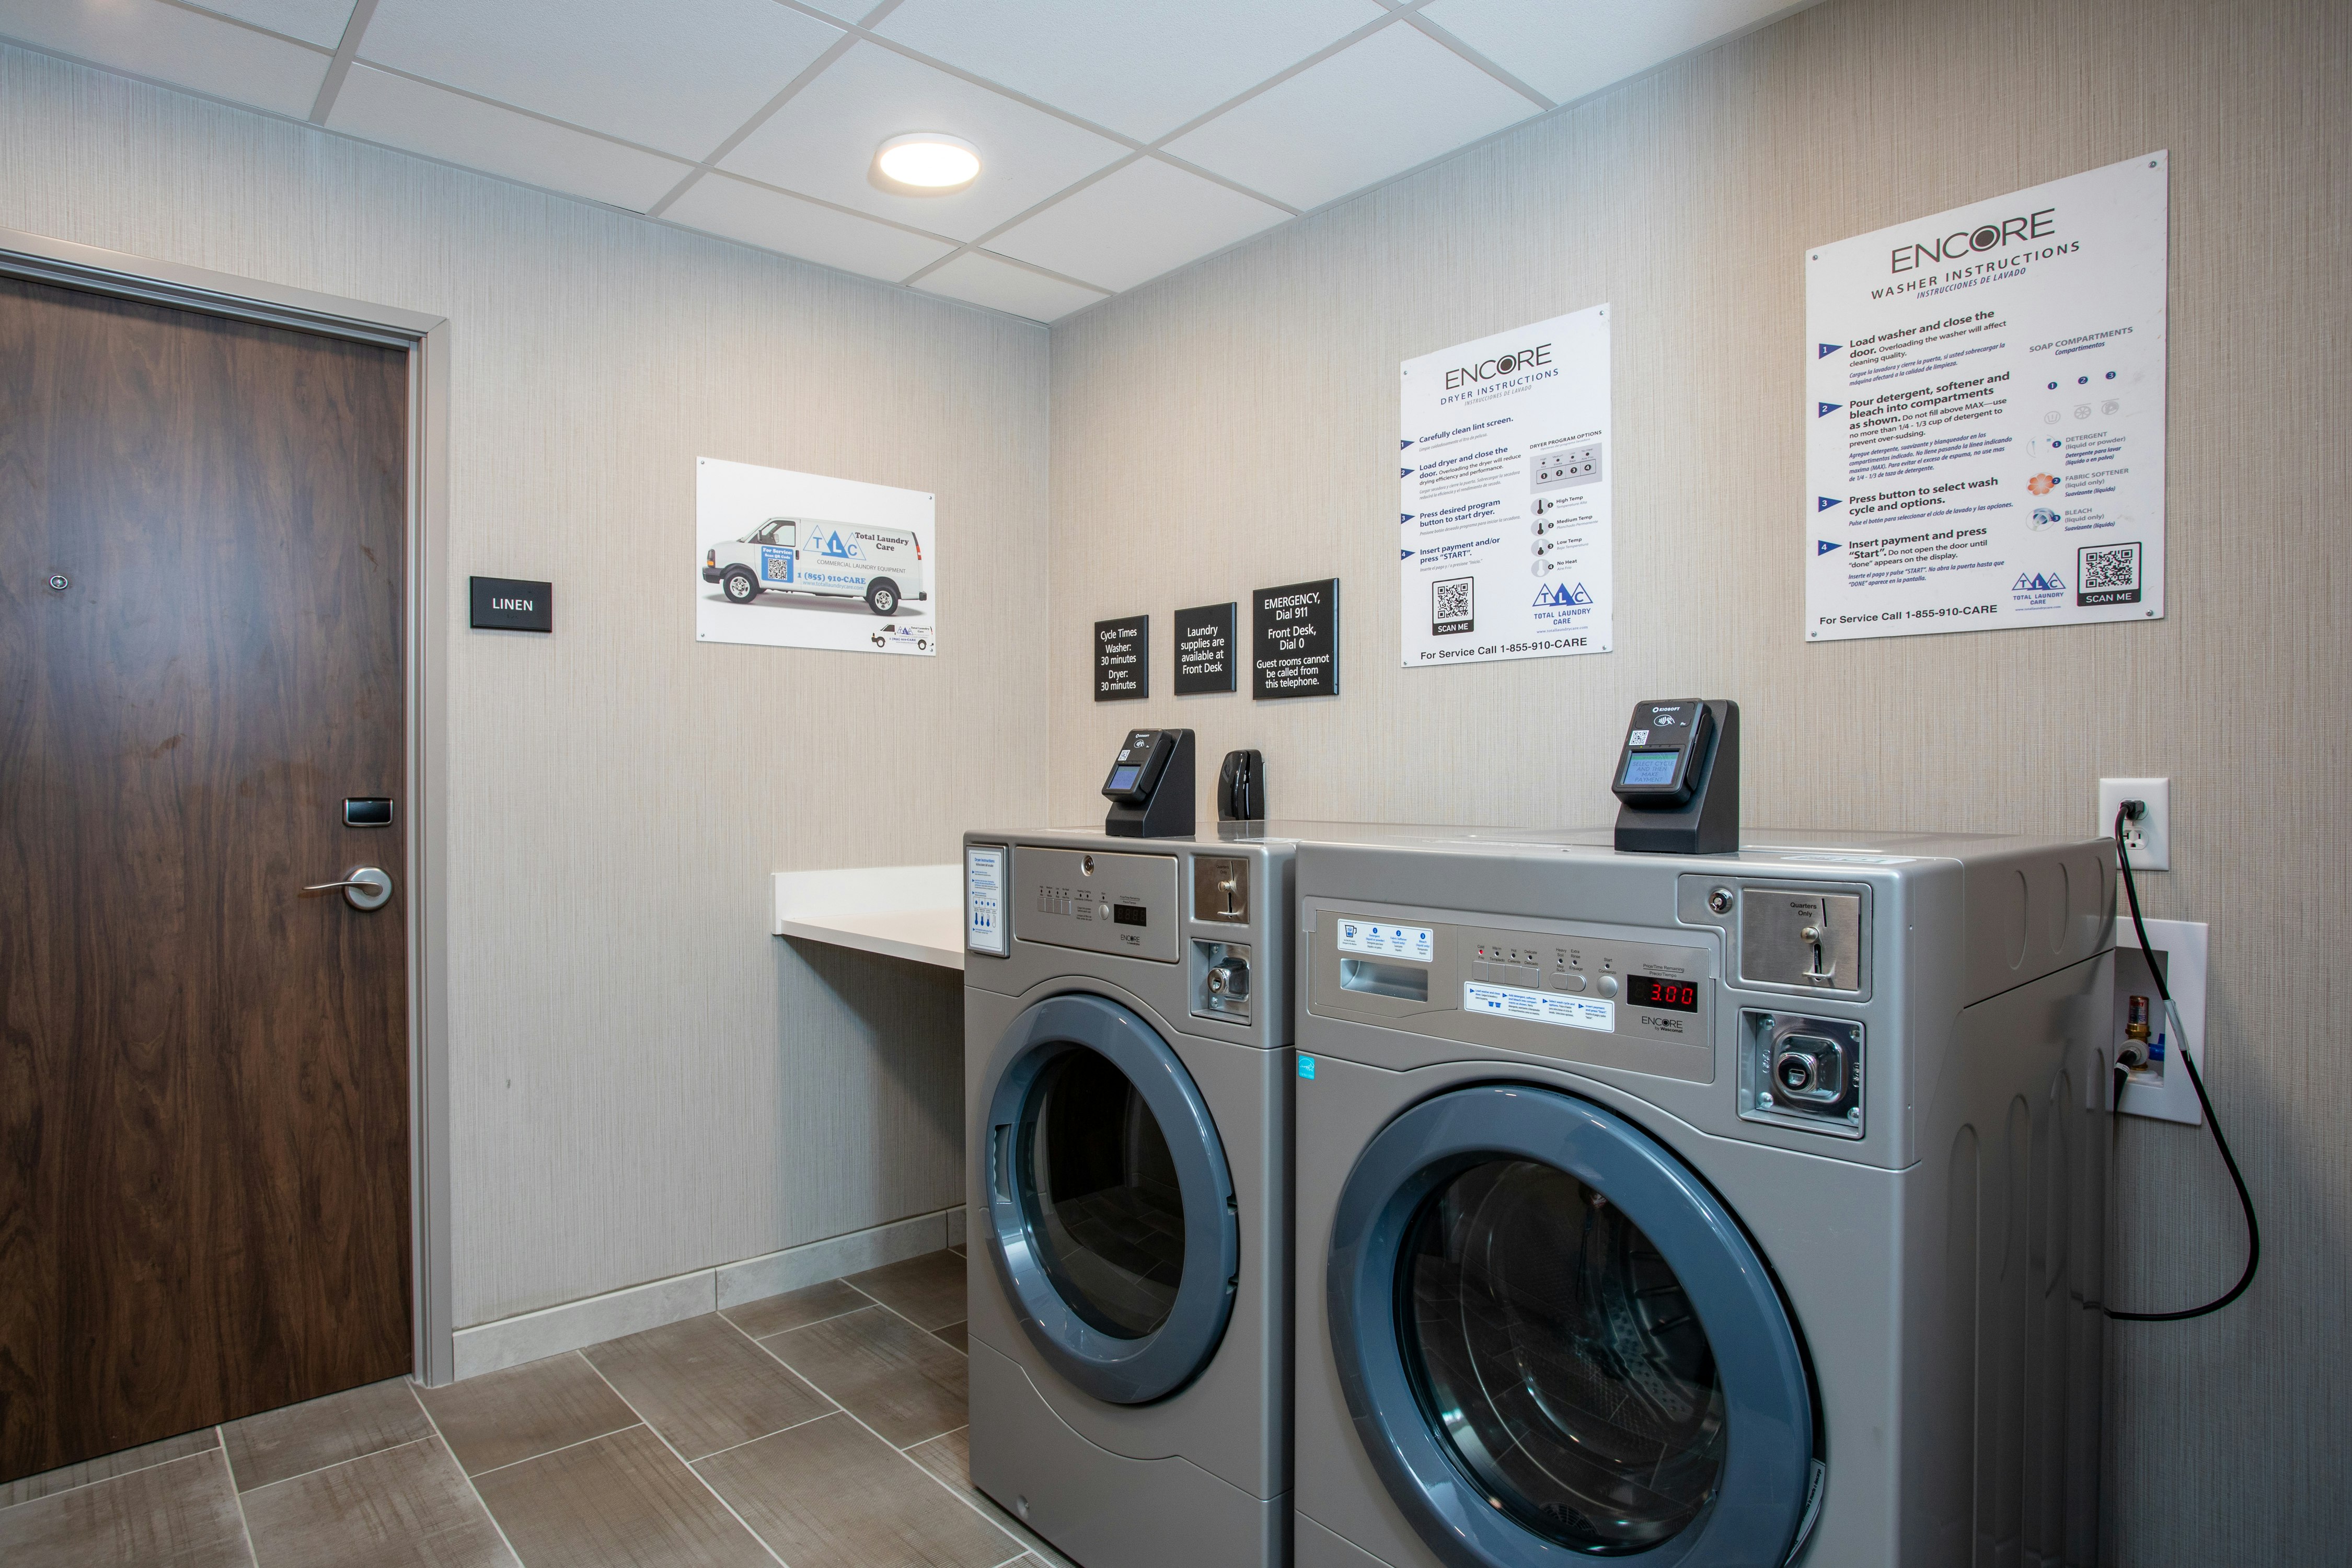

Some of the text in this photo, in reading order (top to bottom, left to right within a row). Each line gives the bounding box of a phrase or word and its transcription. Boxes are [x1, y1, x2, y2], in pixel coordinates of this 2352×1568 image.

[1892, 207, 2055, 274] ENCORE
[1871, 241, 2079, 299] WASHER INSTRUCTIONS
[1917, 267, 2026, 299] INSTRUCCIONES DE LAVADO
[1850, 311, 1994, 348] Load washer and close the
[2030, 326, 2133, 353] SOAP COMPARTMENTS
[2055, 342, 2105, 355] Compartimentos
[1446, 343, 1552, 390] ENCORE
[1440, 368, 1559, 405] DRYER INSTRUCTIONS
[1419, 417, 1514, 443] Carefully clean lint screen.
[1548, 435, 1576, 445] PROGRAM
[1577, 430, 1602, 439] OPTIONS
[2066, 431, 2107, 443] DETERGENT
[1420, 461, 1436, 471] Load
[1438, 458, 1458, 467] dryer
[1459, 453, 1473, 463] and
[1474, 451, 1493, 459] close
[2091, 468, 2129, 478] SOFTENER
[2065, 508, 2092, 516] BLEACH
[855, 532, 909, 546] Total Laundry
[876, 543, 895, 551] Care
[1420, 538, 1500, 555] Insert payment and/or
[817, 559, 852, 568] COMMERCIAL
[804, 572, 825, 582] (855)
[827, 575, 866, 585] 910-CARE
[802, 581, 864, 591] www.totallaundrycare.com
[493, 598, 533, 611] LINEN
[1264, 592, 1320, 609] EMERGENCY,
[2085, 594, 2113, 603] SCAN
[1276, 607, 1308, 620] Dial 911
[1558, 608, 1591, 617] LAUNDRY
[1839, 614, 1878, 624] Service
[1881, 612, 1901, 620] Call
[1906, 604, 1998, 619] 1-855-910-CARE
[1100, 628, 1137, 641] Cycle Times
[1187, 625, 1218, 637] Laundry
[1268, 624, 1317, 639] Front Desk,
[1438, 624, 1456, 632] SCAN
[1105, 643, 1132, 653] Washer:
[1181, 638, 1225, 651] supplies are
[1280, 638, 1305, 650] Dial 0
[1439, 648, 1475, 658] Service
[1478, 645, 1496, 655] Call
[1500, 637, 1587, 653] 1-855-910-CARE
[1101, 654, 1136, 666] 30 minutes
[1181, 649, 1224, 662] available at
[1256, 654, 1330, 669] Guest rooms cannot
[1183, 663, 1223, 674] Front Desk
[1266, 666, 1319, 678] be called from
[1109, 670, 1128, 681] Dryer:
[1101, 681, 1136, 691] 30 minutes
[1265, 677, 1319, 688] this telephone.
[1651, 984, 1693, 1005] 3.00
[1642, 1016, 1683, 1029] ENCORE
